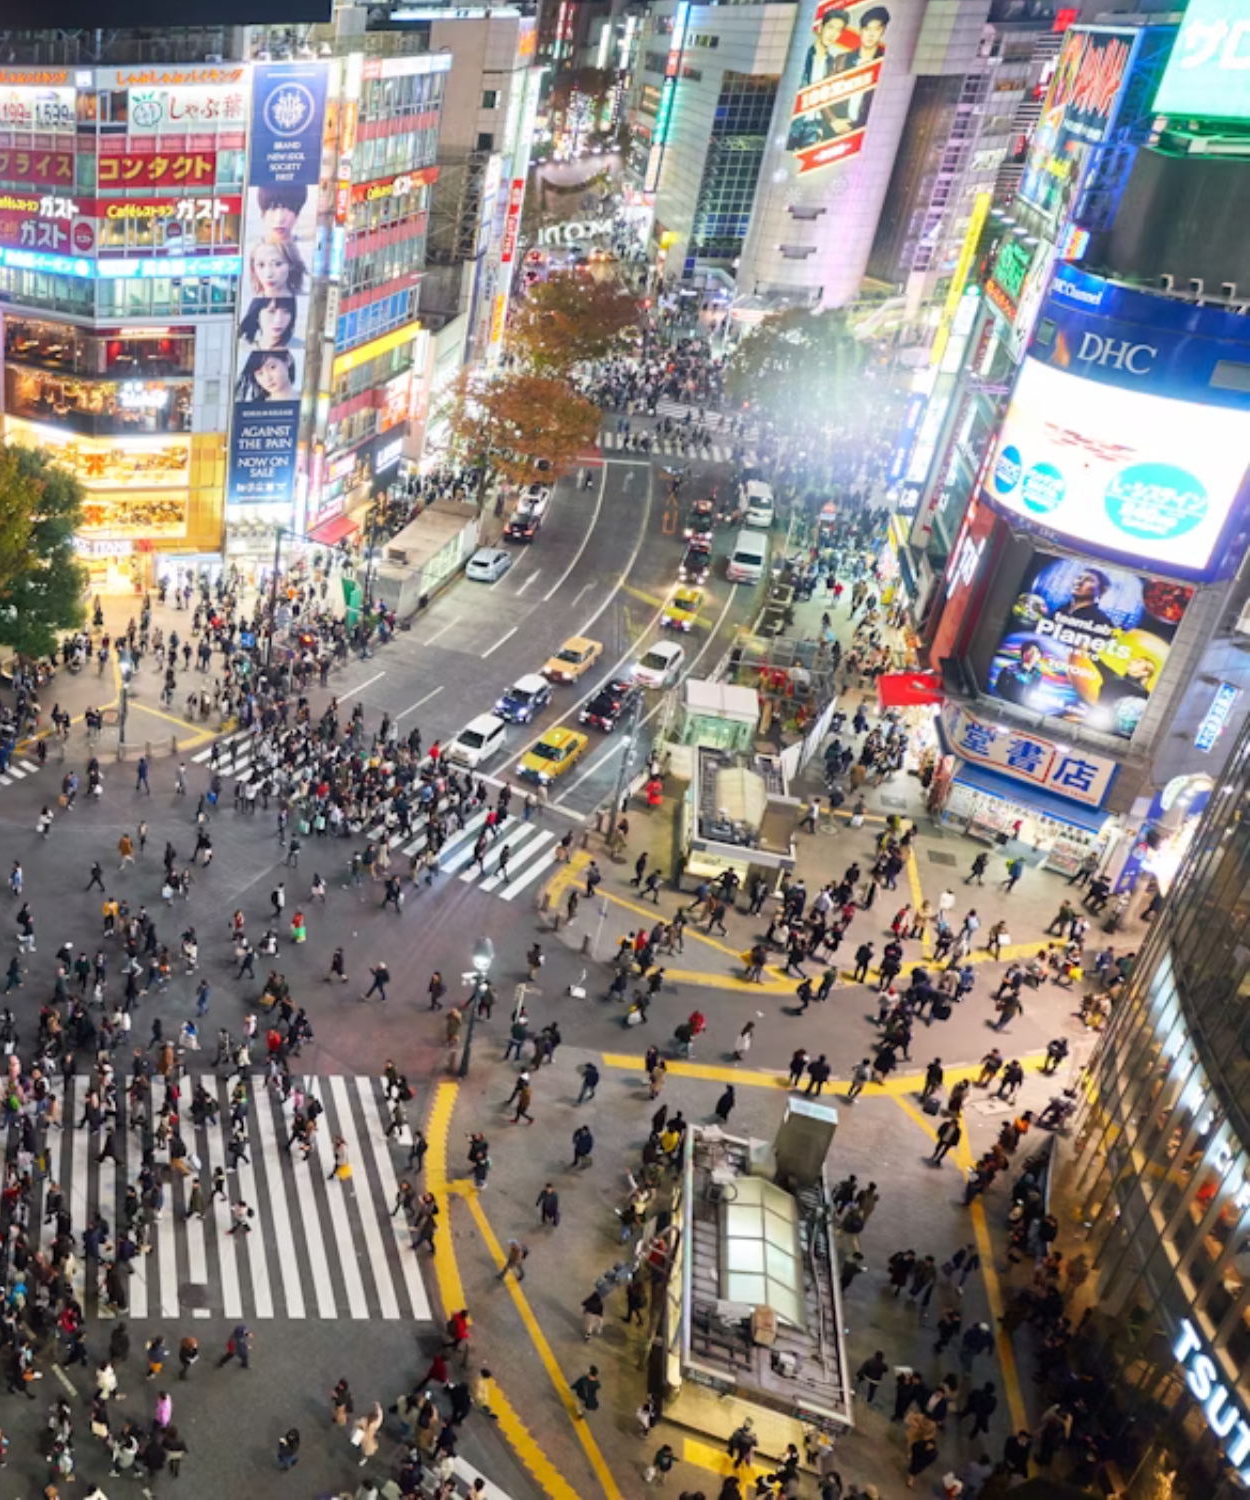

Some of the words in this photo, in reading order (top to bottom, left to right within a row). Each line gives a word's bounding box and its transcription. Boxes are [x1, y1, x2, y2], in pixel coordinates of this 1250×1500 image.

[100, 155, 212, 180] コンタクト
[39, 195, 80, 219] ガスト
[176, 195, 230, 220] ガスト
[21, 219, 68, 250] ガスト
[1077, 331, 1157, 375] DHC
[241, 425, 292, 437] AGAINST
[238, 439, 262, 450] THE
[265, 438, 293, 449] PAIN
[237, 457, 268, 468] NOW
[269, 456, 289, 467] ON
[249, 467, 275, 478] SALE
[1035, 618, 1131, 660] Planets
